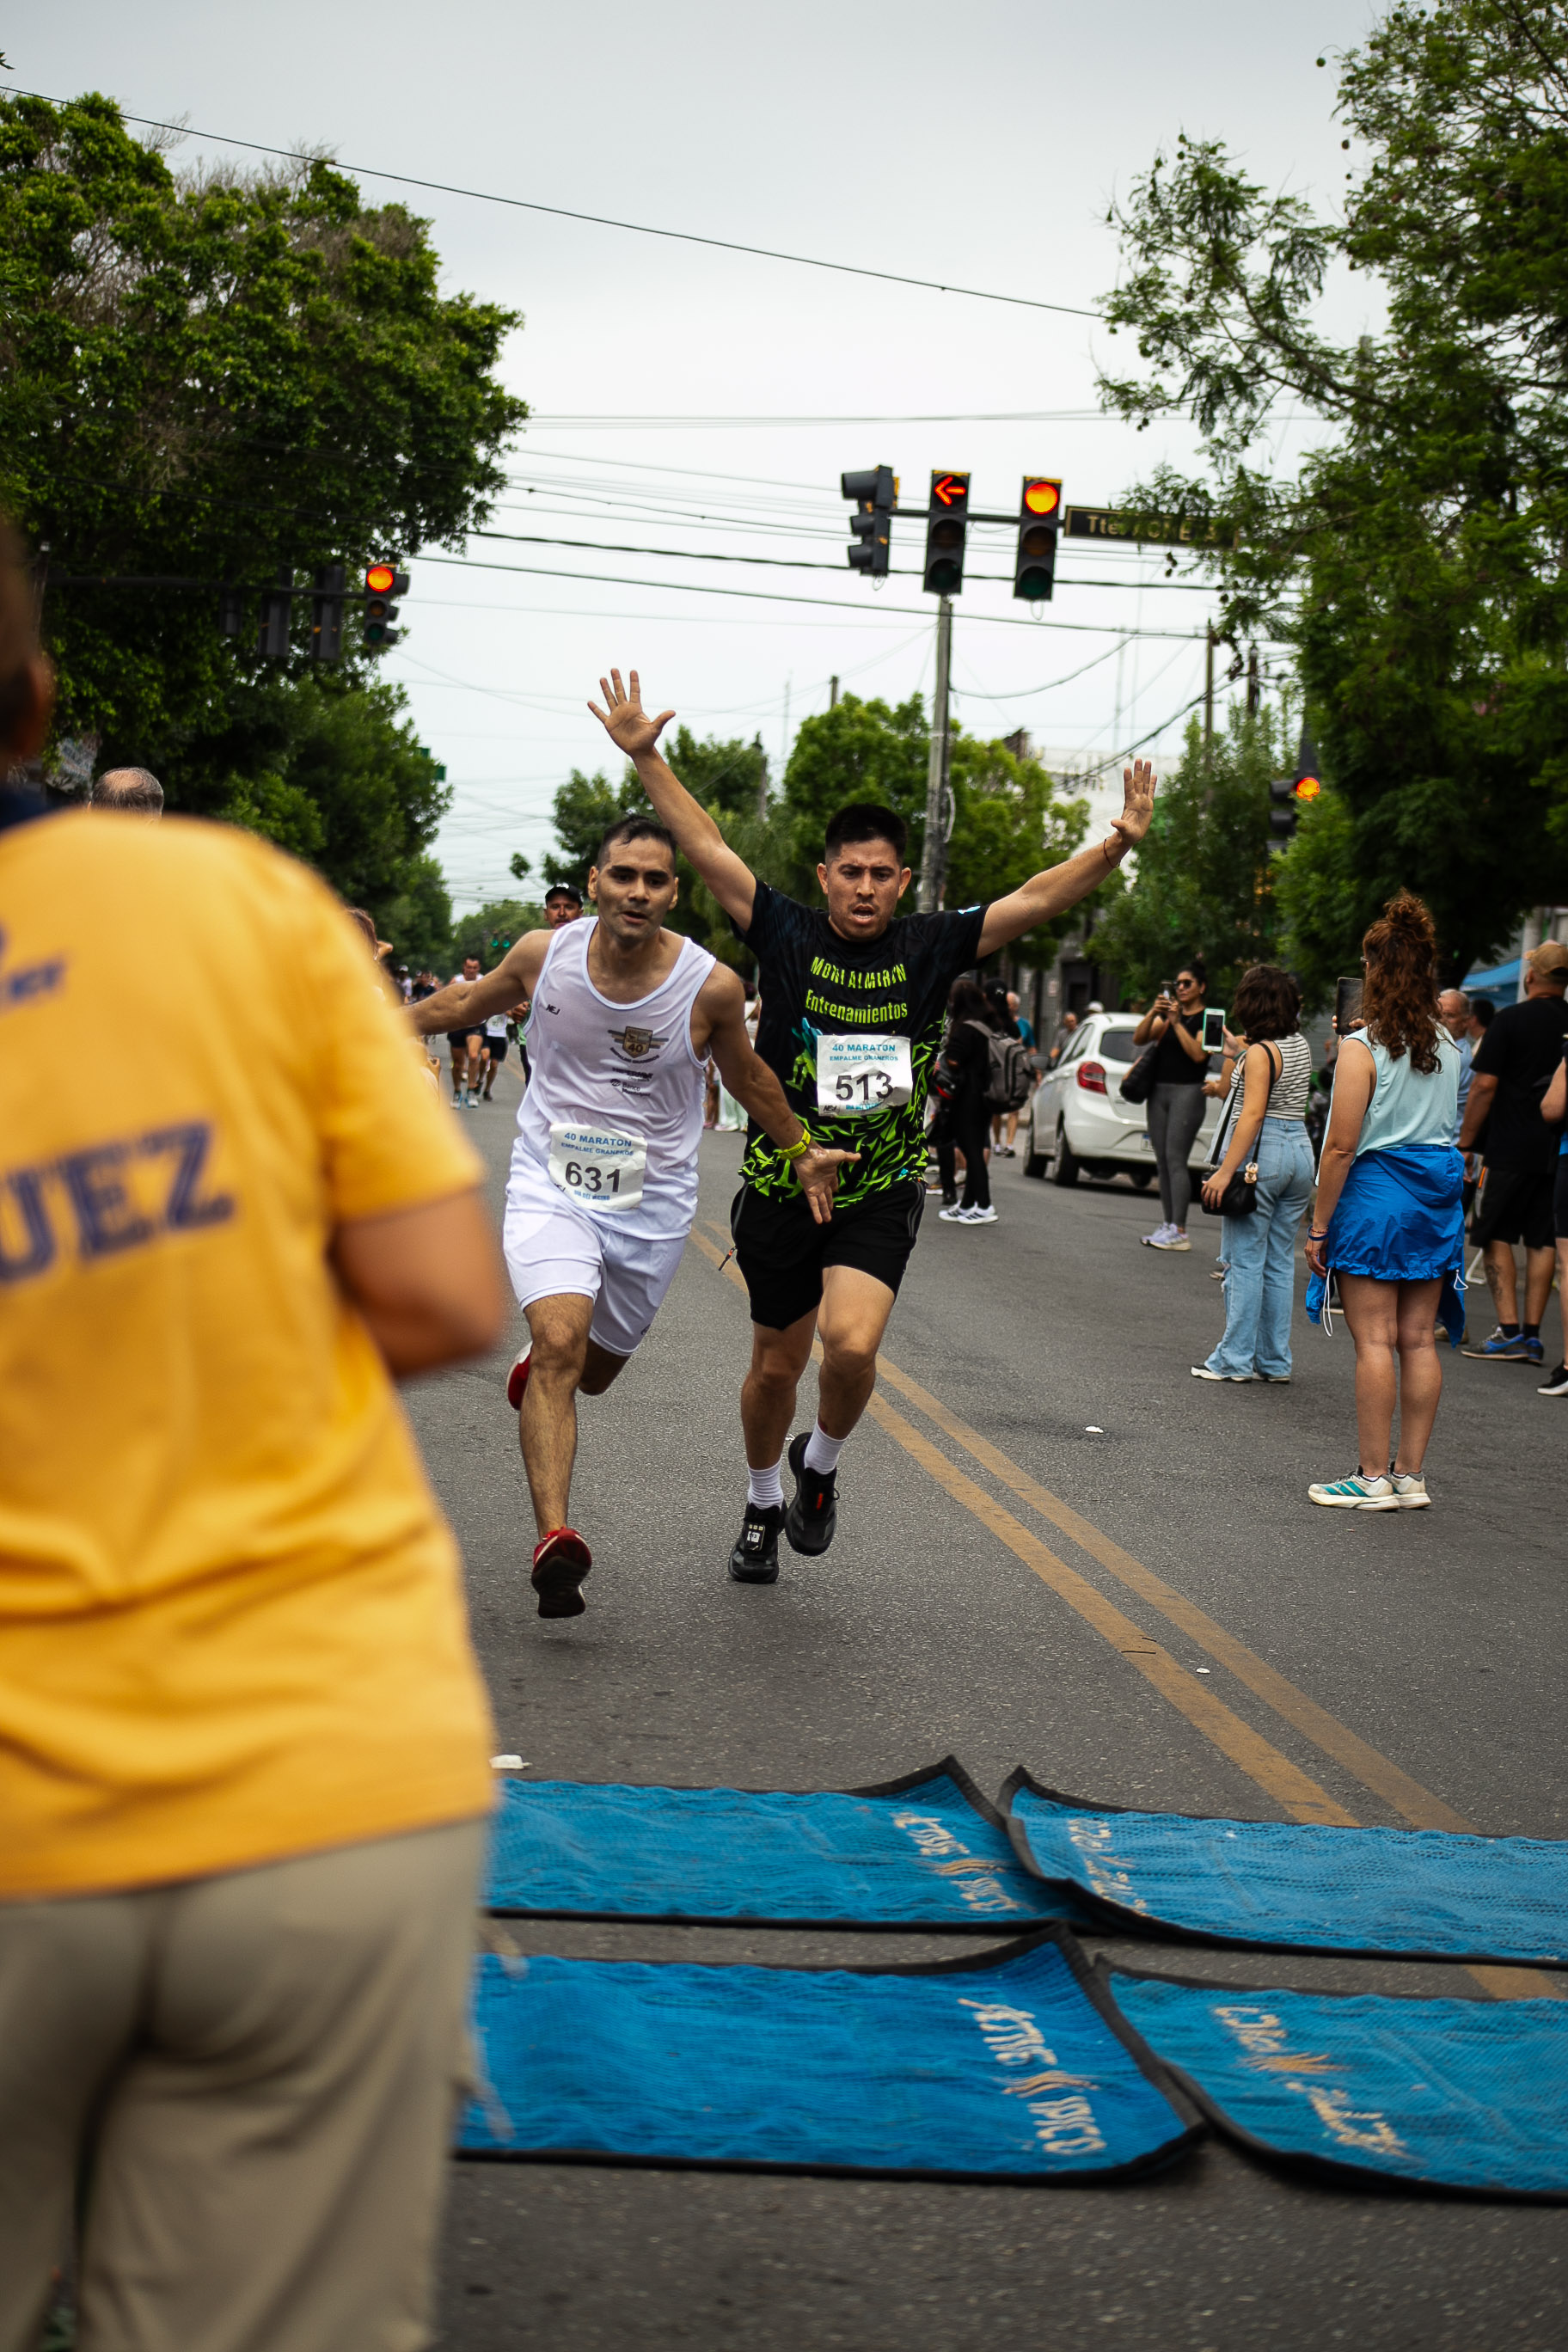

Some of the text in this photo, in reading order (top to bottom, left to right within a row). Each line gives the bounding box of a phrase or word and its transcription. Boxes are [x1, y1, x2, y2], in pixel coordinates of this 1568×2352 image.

[805, 989, 908, 1024] Entrenamientos
[628, 1044, 644, 1053] 40
[847, 1044, 896, 1052] MARATON
[836, 1070, 894, 1101] 513
[564, 1132, 632, 1148] 40 MARATON
[561, 1142, 634, 1156] EMPALME GRANEROS
[565, 1161, 621, 1193] 631
